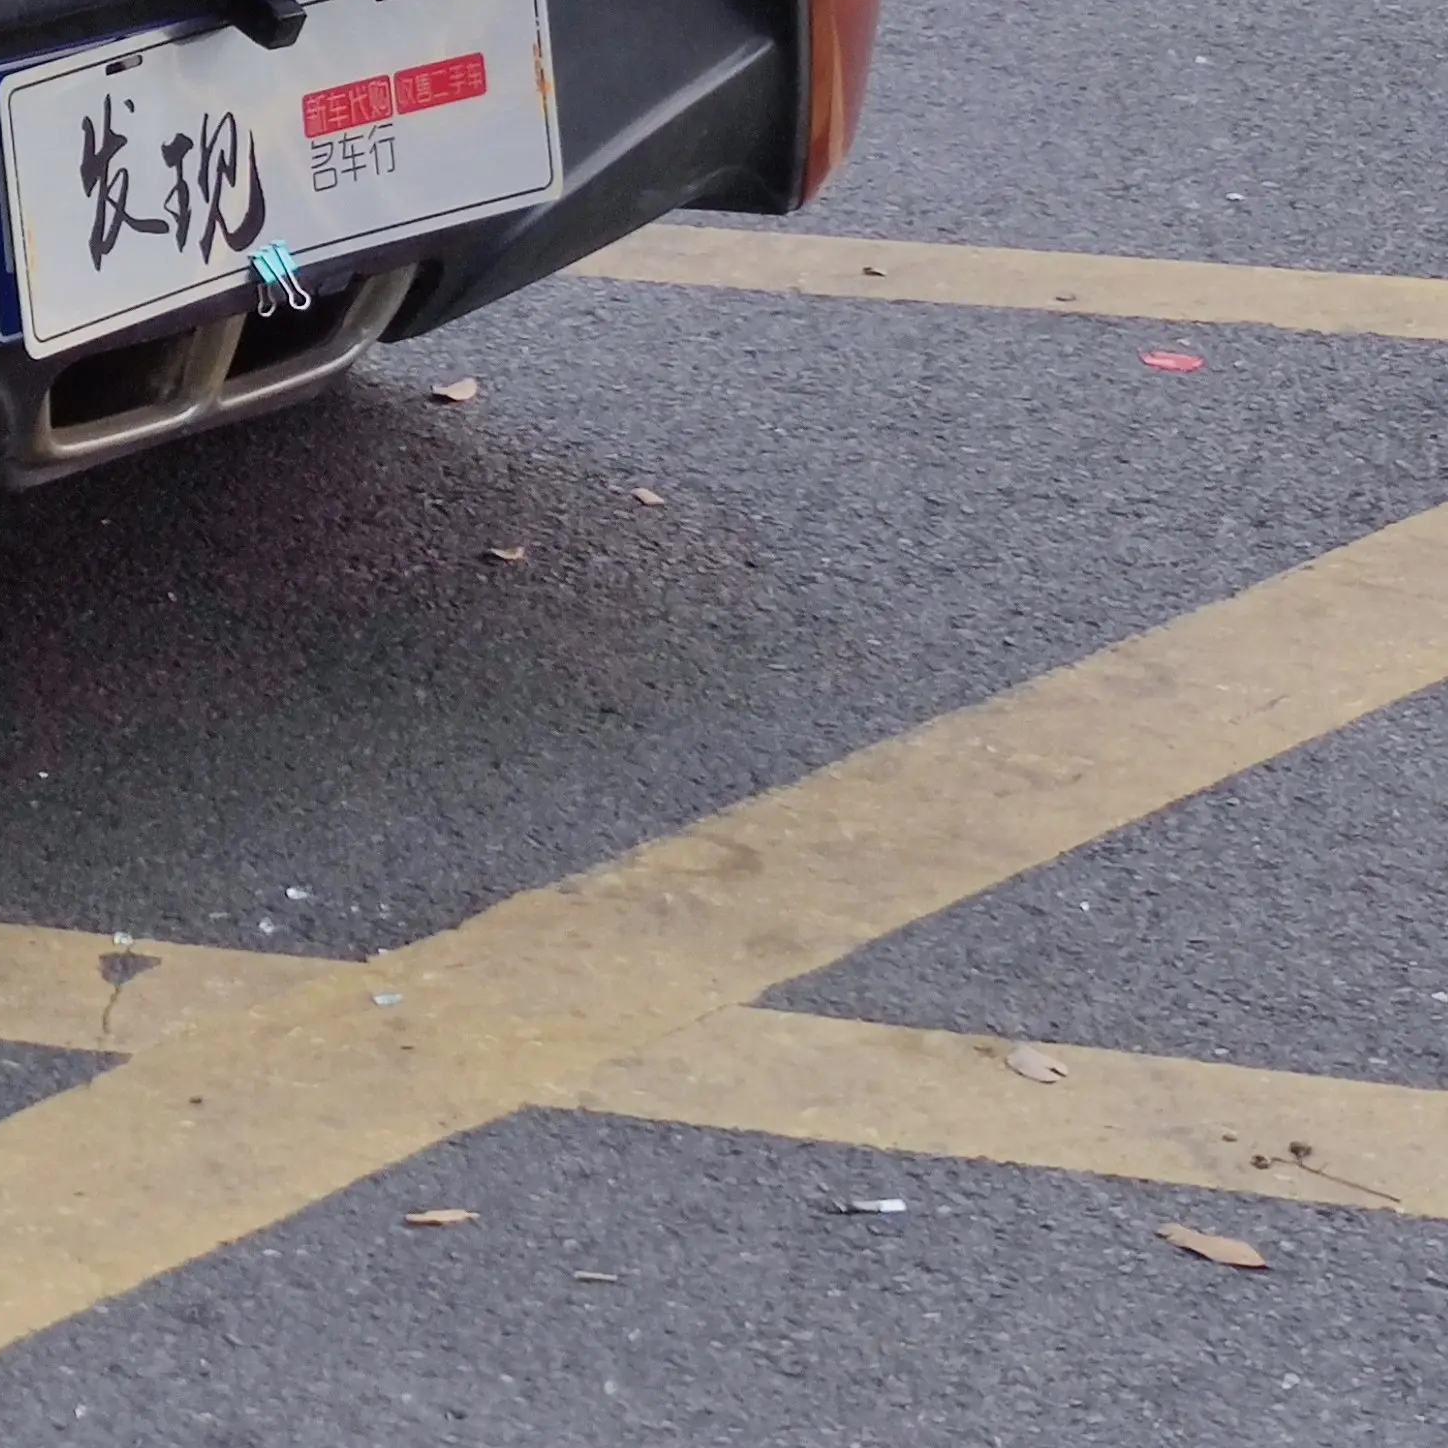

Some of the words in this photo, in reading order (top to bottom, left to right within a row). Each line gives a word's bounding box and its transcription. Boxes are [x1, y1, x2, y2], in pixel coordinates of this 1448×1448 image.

[304, 77, 394, 131] 新车代购
[79, 93, 266, 272] 发现
[310, 123, 397, 193] 名车行
